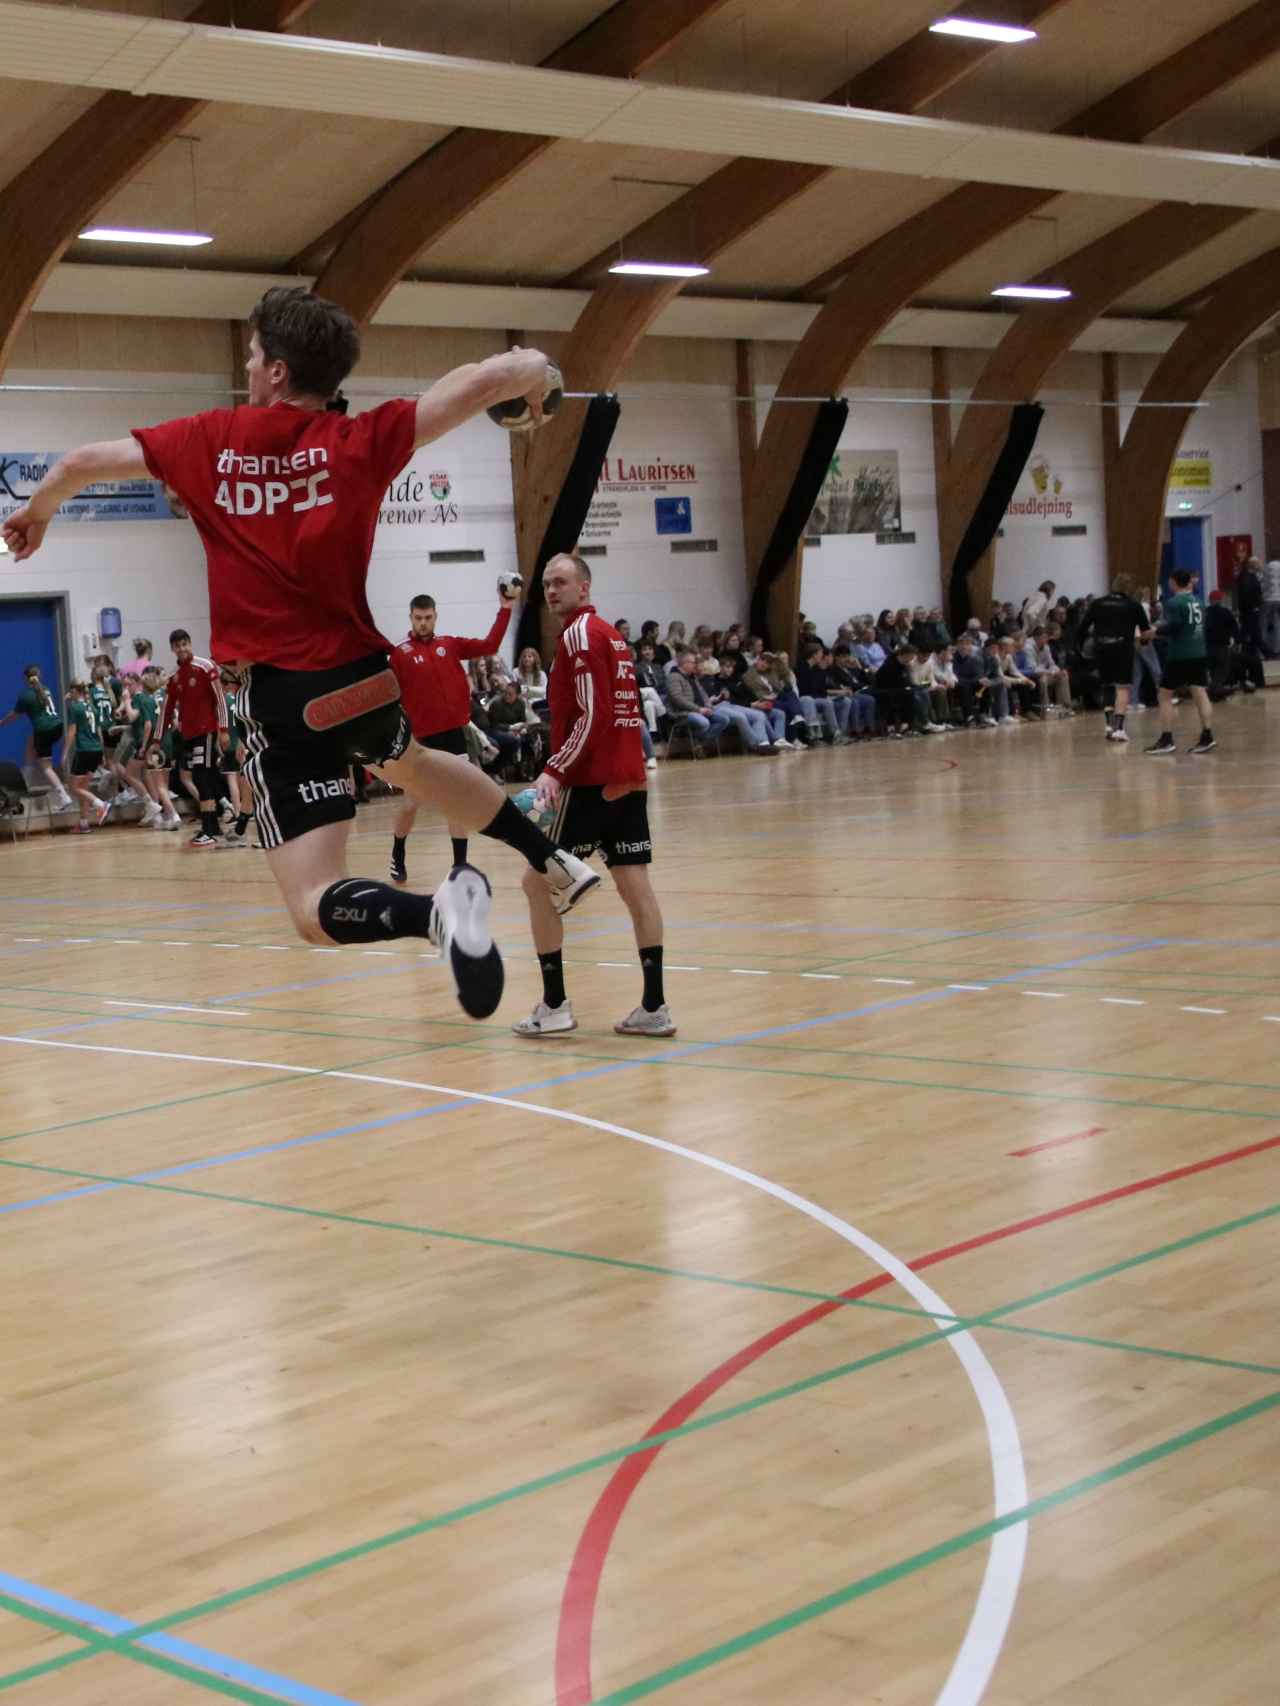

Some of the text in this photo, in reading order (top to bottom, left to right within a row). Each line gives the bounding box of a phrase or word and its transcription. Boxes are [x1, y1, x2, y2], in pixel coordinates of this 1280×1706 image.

[217, 448, 328, 475] thansen
[1187, 602, 1202, 625] 15
[331, 906, 368, 922] 2XU
